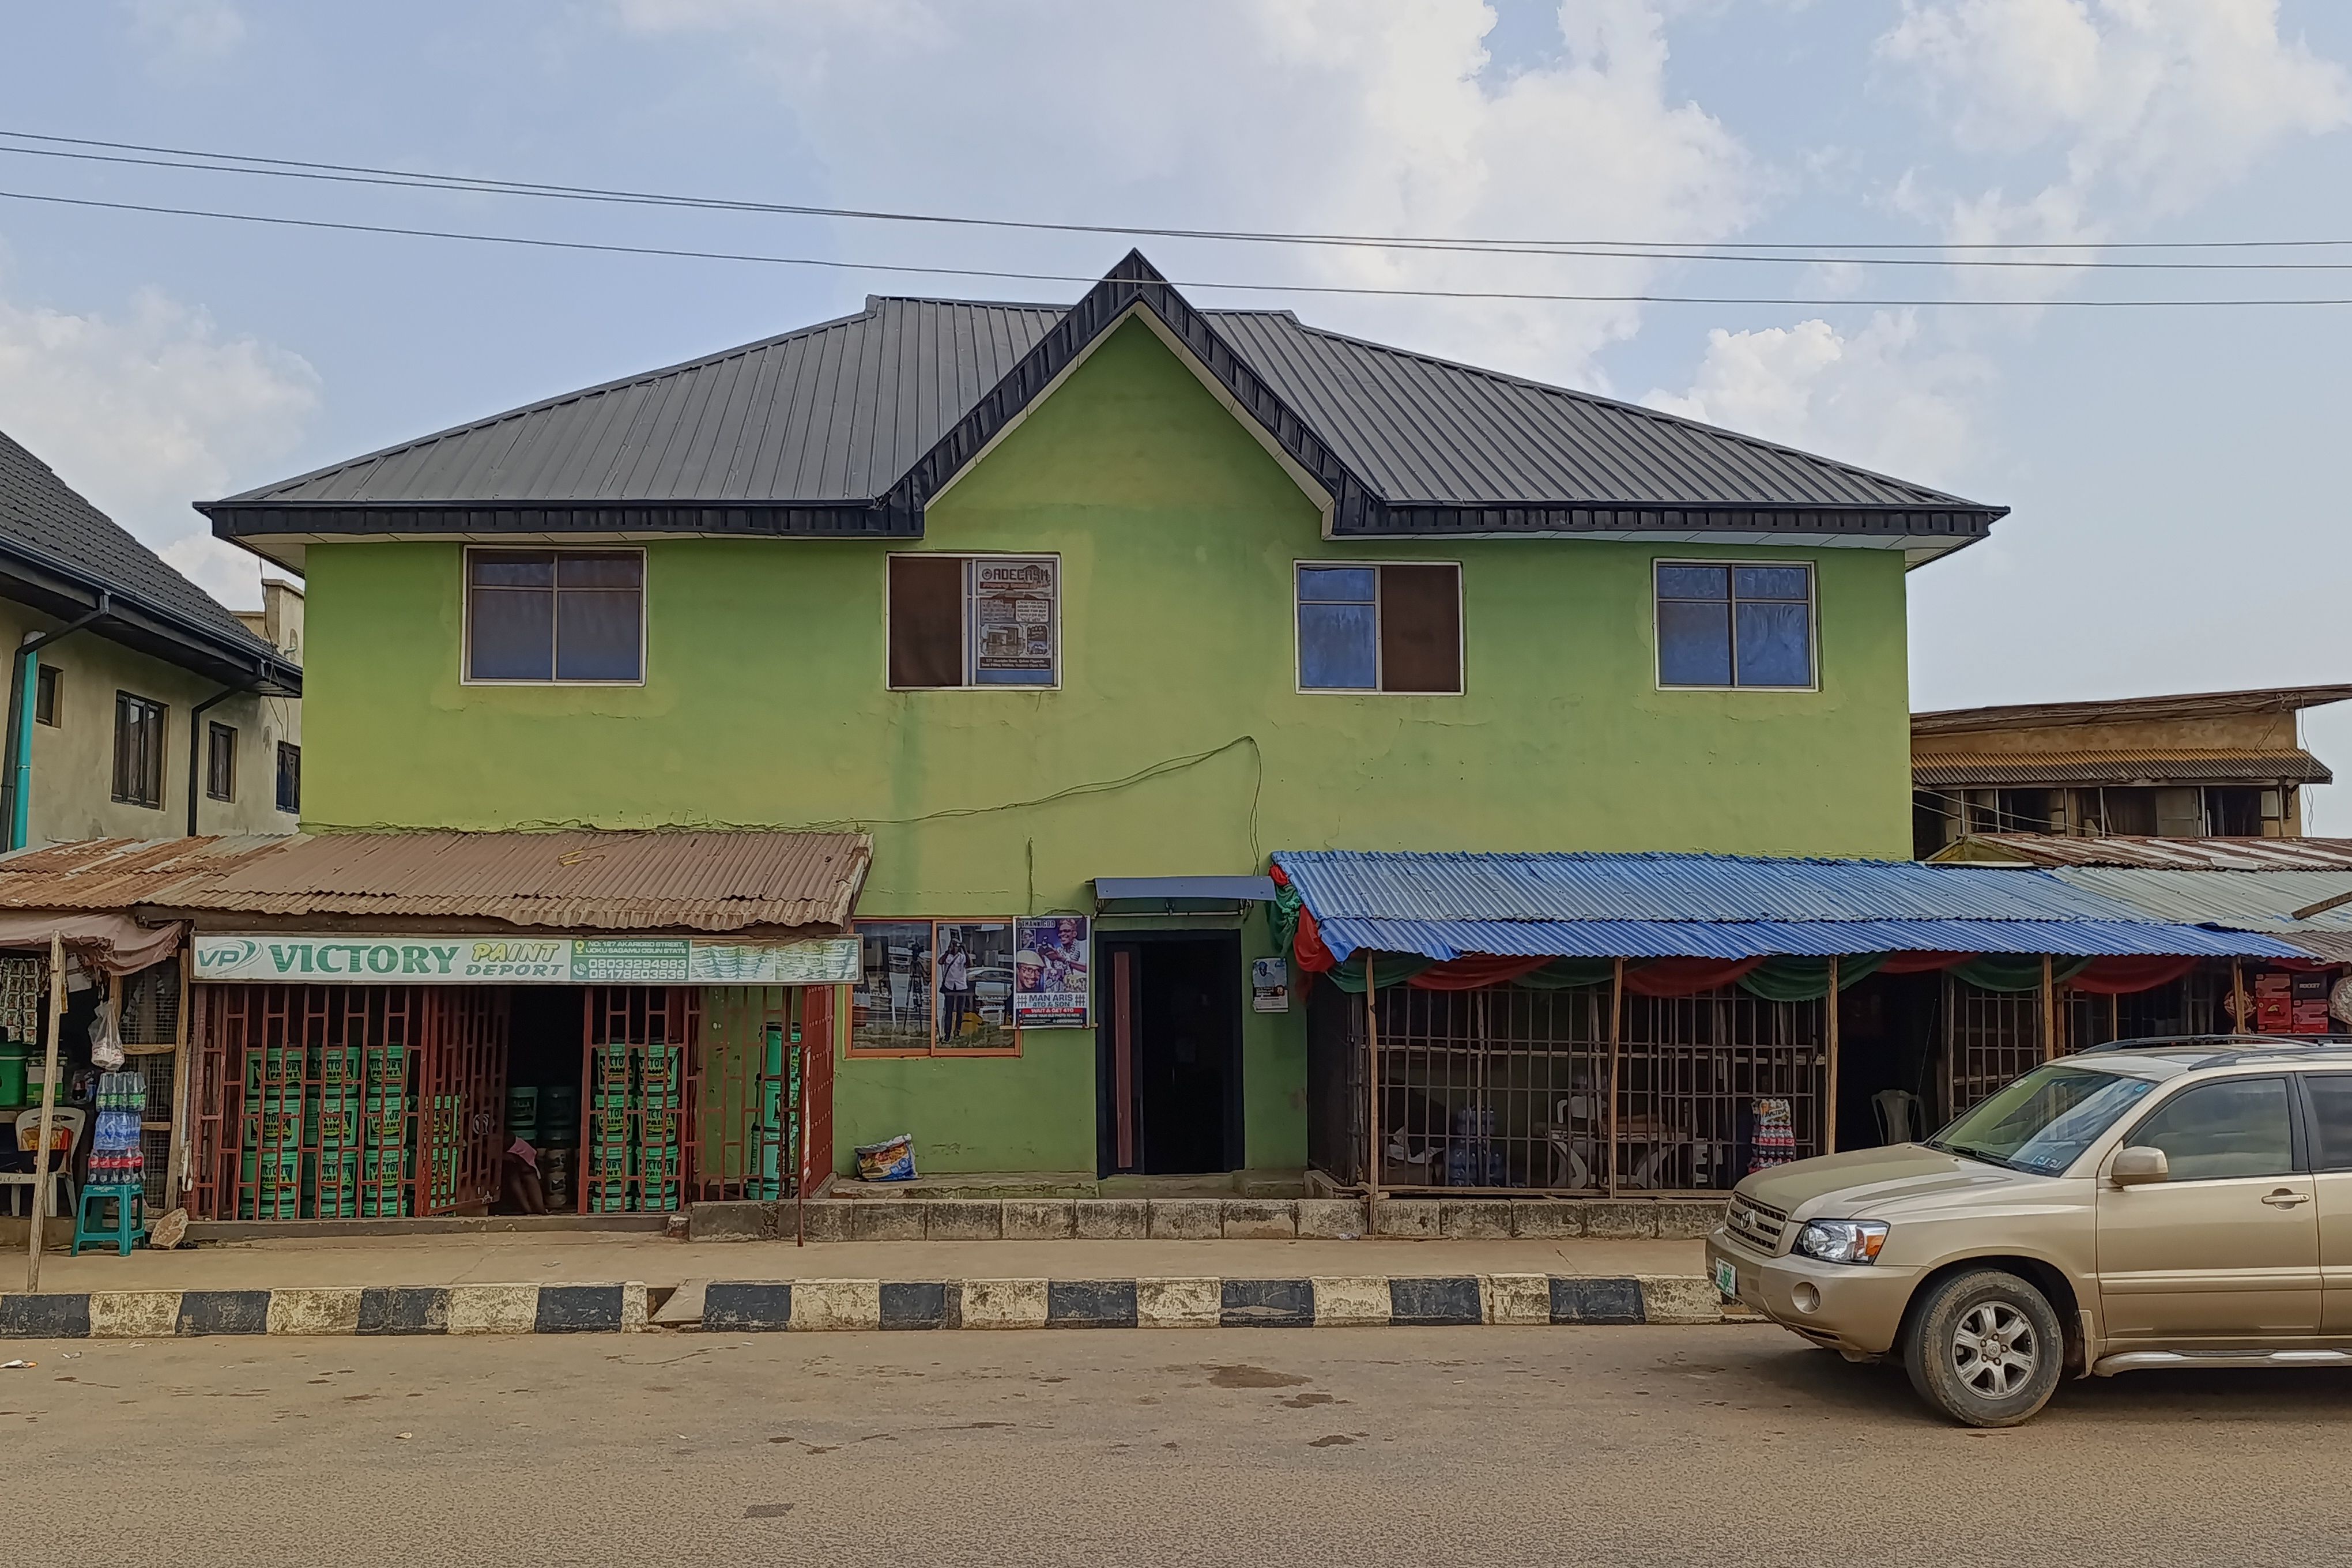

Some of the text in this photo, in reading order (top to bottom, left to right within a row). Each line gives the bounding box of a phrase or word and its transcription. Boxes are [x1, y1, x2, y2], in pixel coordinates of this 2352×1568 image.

[993, 568, 1048, 581] ADECASH
[198, 950, 240, 967] VP
[268, 944, 461, 974] VICTORY
[472, 943, 560, 962] PAINT
[465, 964, 564, 976] DEPORT
[589, 969, 685, 979] 08178203539
